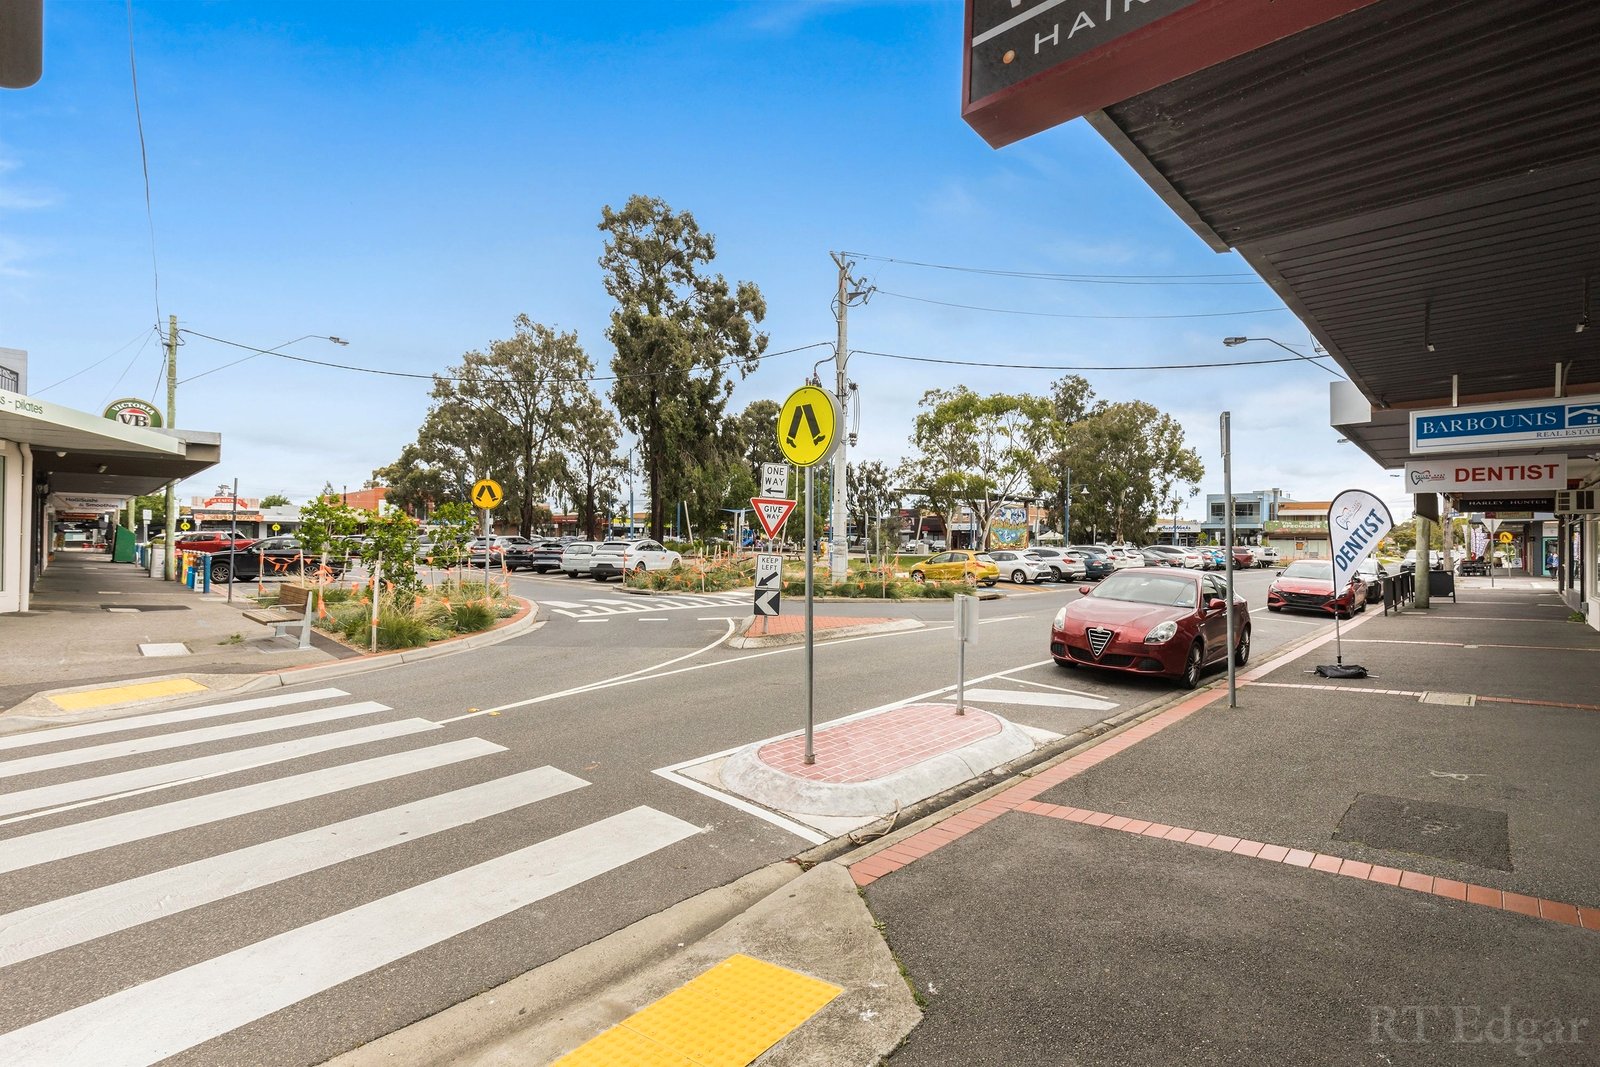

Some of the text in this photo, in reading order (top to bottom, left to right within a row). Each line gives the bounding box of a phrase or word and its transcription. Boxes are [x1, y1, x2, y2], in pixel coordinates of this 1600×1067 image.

[15, 399, 44, 415] pilates
[112, 402, 156, 415] VICTORIA
[119, 413, 149, 427] VB
[1422, 411, 1557, 434] BARBOUNIS
[766, 466, 785, 476] ONE
[1454, 463, 1560, 483] DENTIST
[765, 477, 785, 486] WAY
[764, 505, 783, 514] GIVE
[1335, 508, 1385, 572] DENTIST
